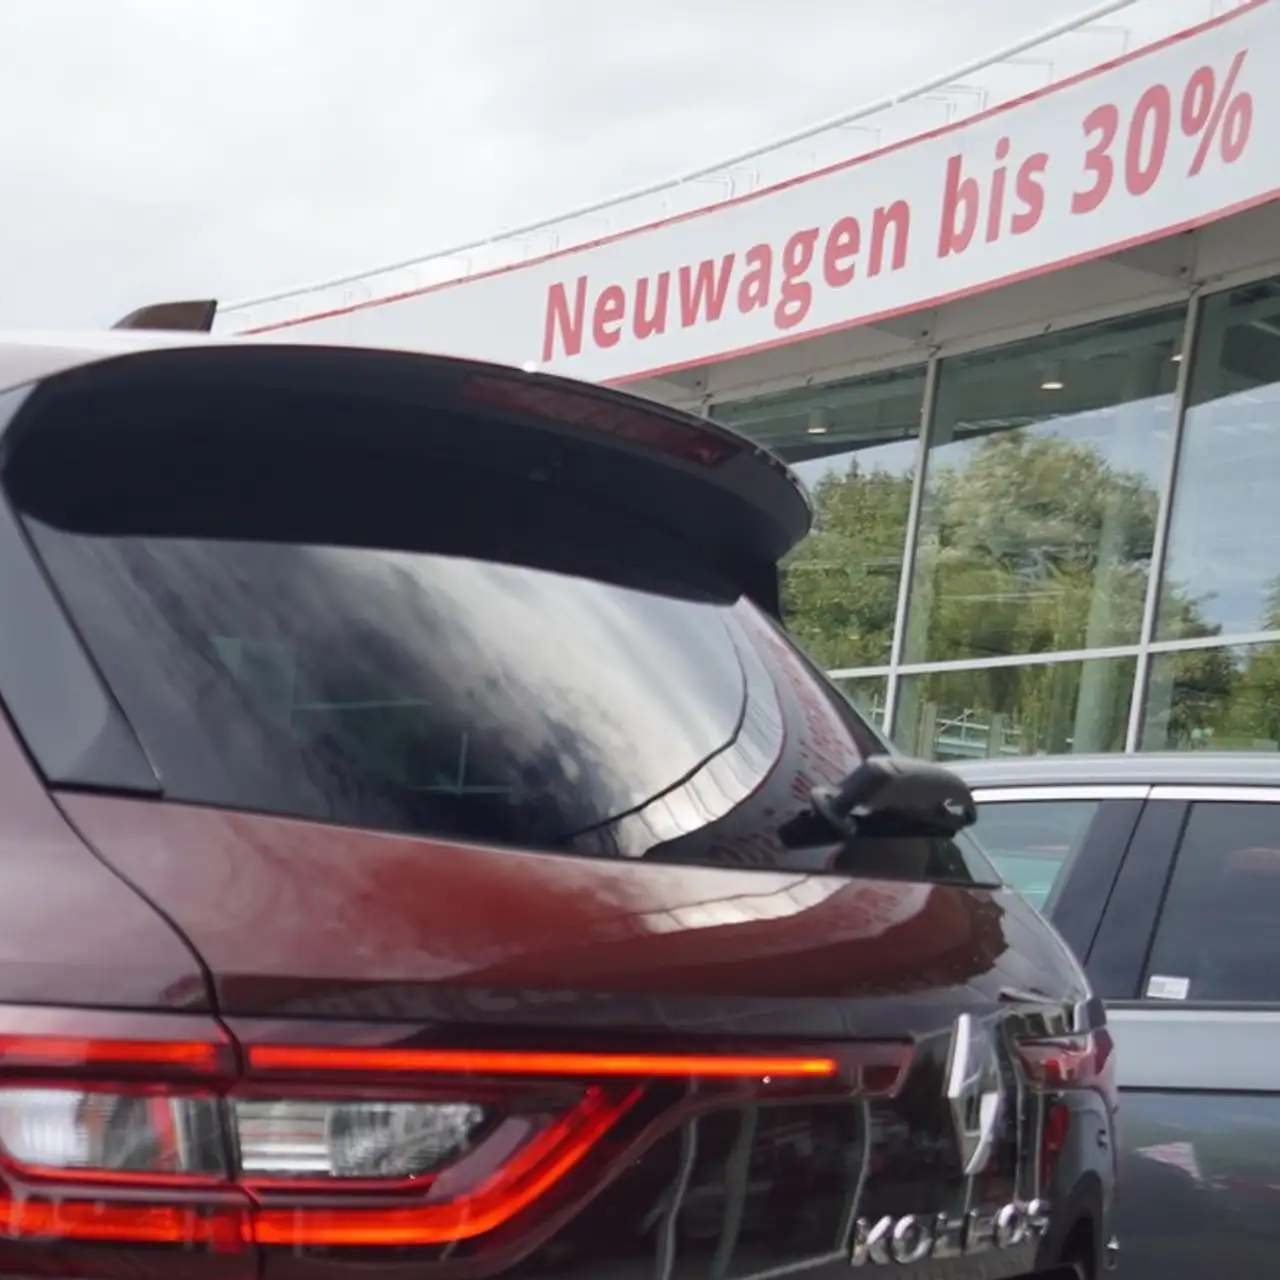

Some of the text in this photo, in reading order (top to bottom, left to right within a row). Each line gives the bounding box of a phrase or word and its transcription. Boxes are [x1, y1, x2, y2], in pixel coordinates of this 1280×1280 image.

[543, 49, 1254, 362] Neuwagen bis 30%
[851, 1197, 1050, 1267] KOLEOS
